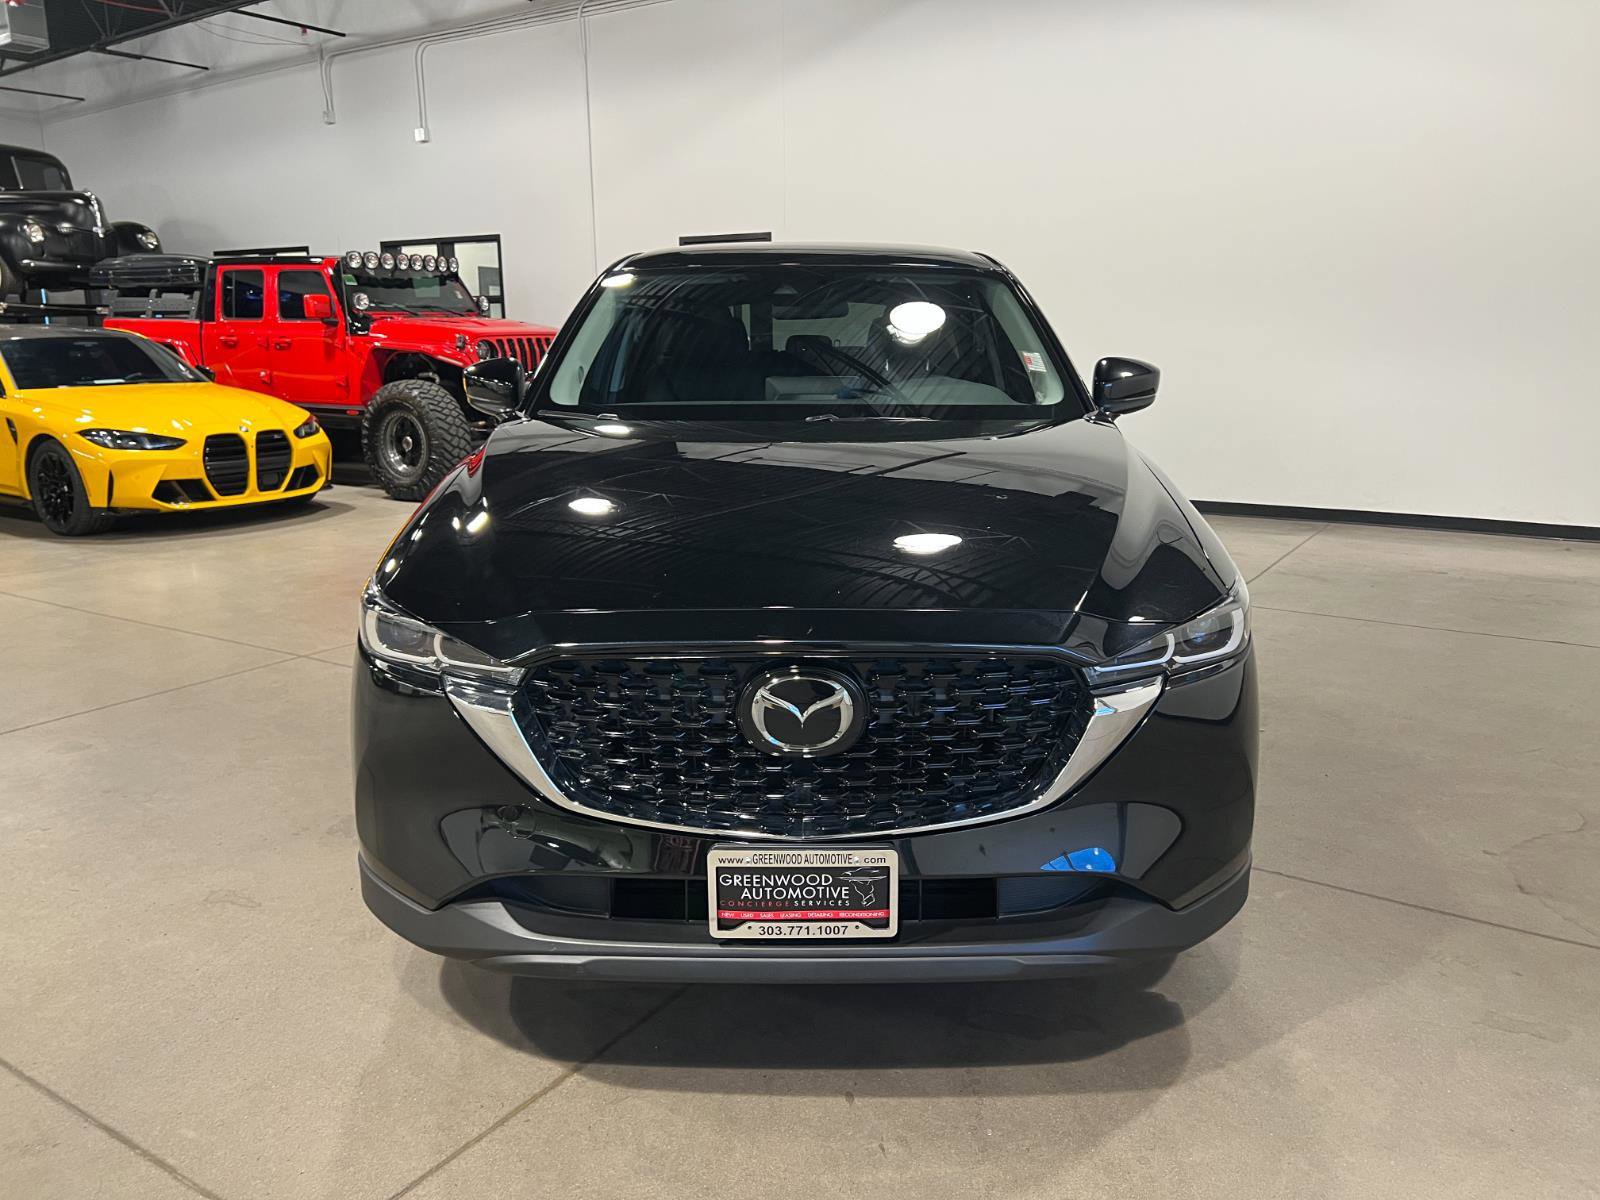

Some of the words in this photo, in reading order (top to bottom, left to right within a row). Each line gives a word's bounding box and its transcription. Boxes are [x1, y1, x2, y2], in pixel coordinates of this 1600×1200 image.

[752, 854, 802, 864] GREENWOOD
[804, 854, 852, 864] AUTOMOTIVE
[719, 874, 832, 886] GREENWOOD
[740, 887, 850, 899] AUTOMOTIVE
[758, 925, 848, 936] 303.771.1007
